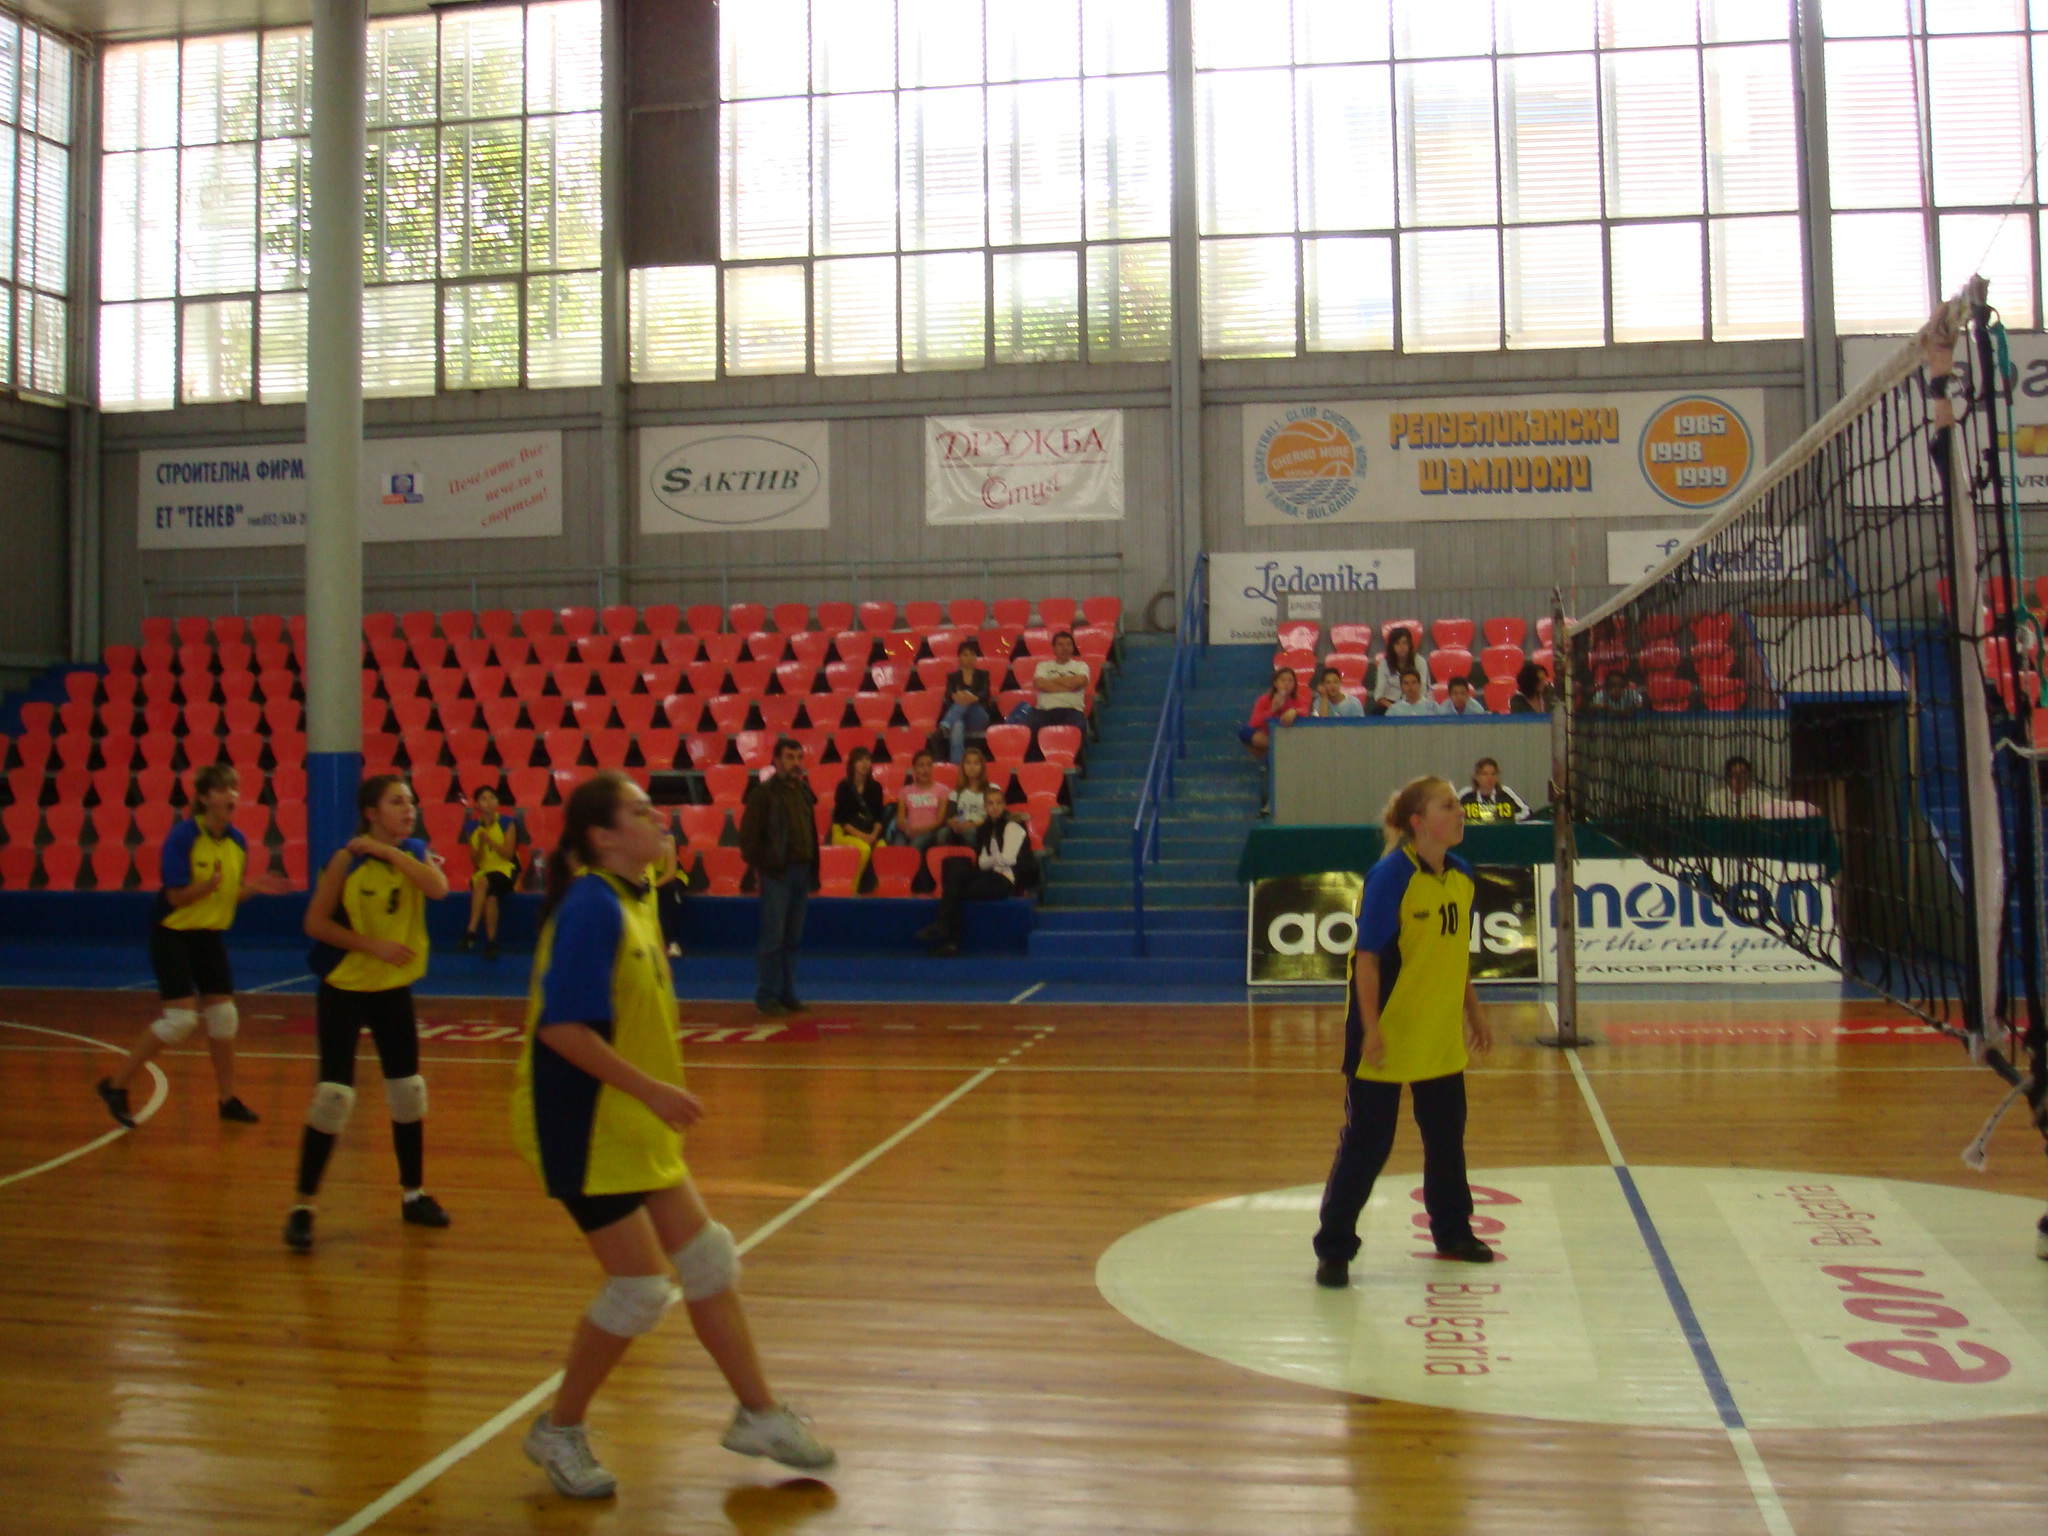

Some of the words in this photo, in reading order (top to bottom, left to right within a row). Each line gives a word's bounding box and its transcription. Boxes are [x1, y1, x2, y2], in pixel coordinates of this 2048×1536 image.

[1673, 414, 1729, 437] 1985
[936, 428, 1107, 461] ДРУЖБА
[1650, 441, 1702, 463] 1998
[156, 461, 250, 485] СТРОИТЕЛНА
[256, 458, 305, 480] ФИРМ
[1675, 466, 1728, 489] 1999
[156, 506, 173, 528] ЕТ
[1550, 872, 1822, 930] molten
[1438, 902, 1459, 936] 10
[1774, 1184, 1882, 1247] Bulgaria
[1405, 1282, 1512, 1376] Bulgaria
